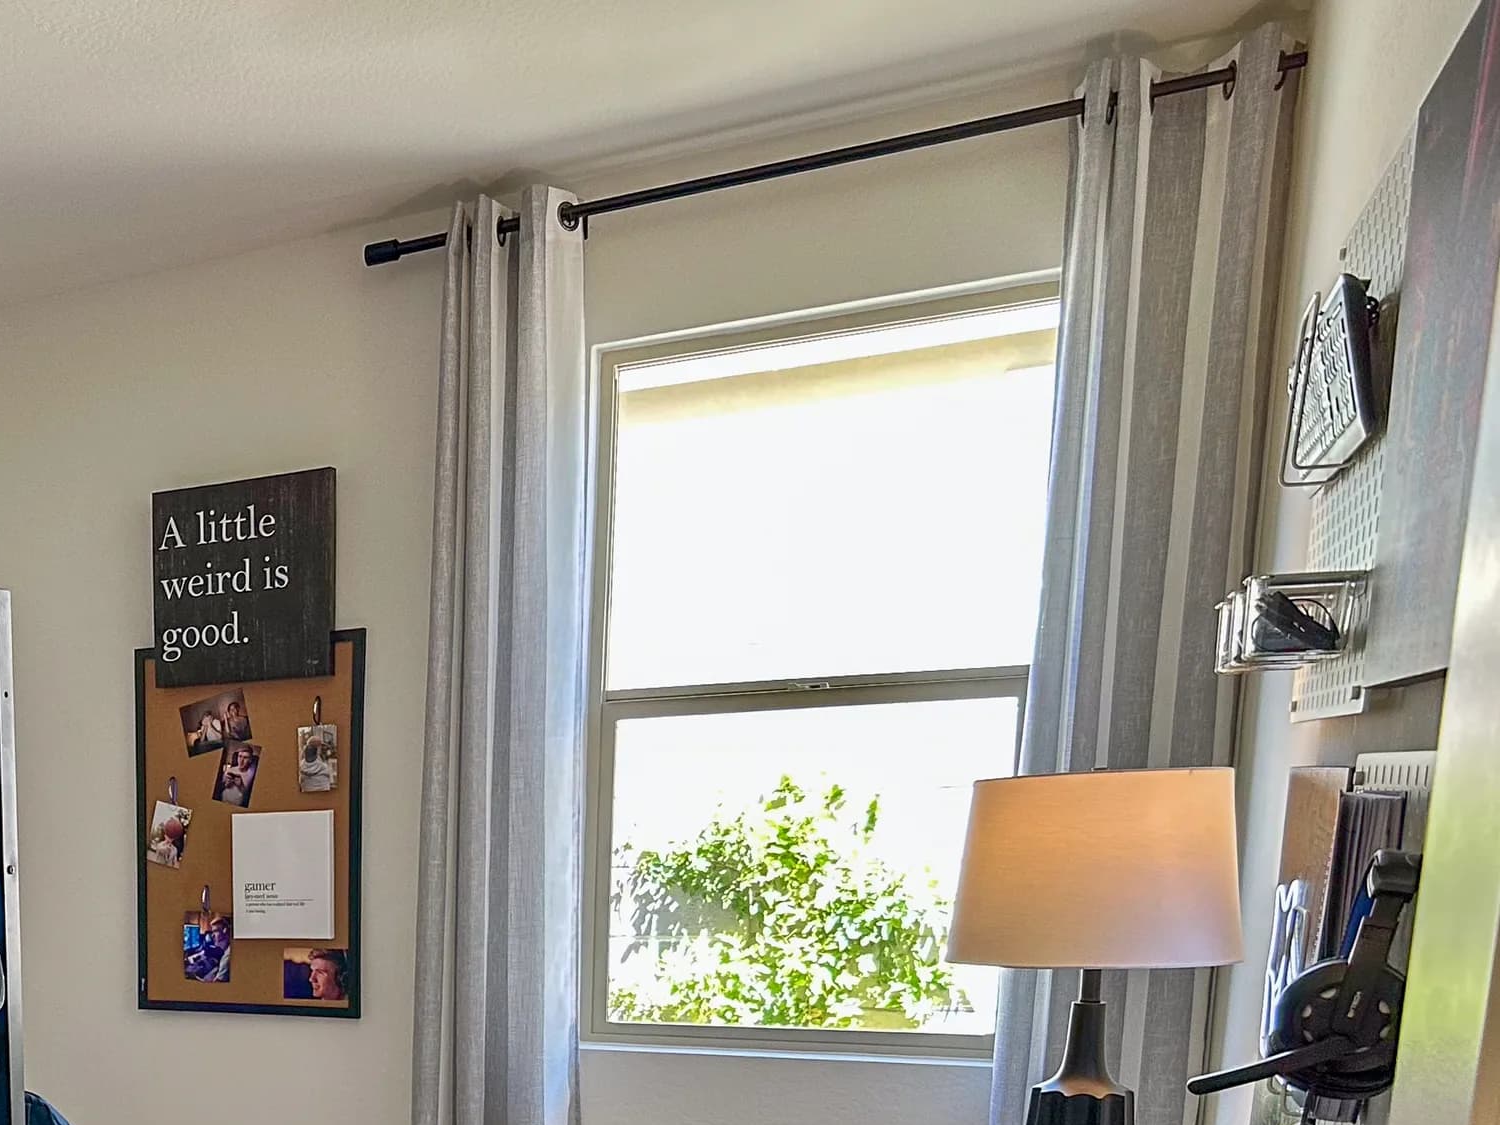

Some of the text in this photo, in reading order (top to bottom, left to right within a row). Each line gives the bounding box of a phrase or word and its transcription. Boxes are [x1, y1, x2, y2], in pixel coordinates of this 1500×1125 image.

[158, 504, 276, 550] A little
[160, 556, 289, 600] weird is
[162, 611, 249, 662] good.
[244, 882, 277, 893] gamer
